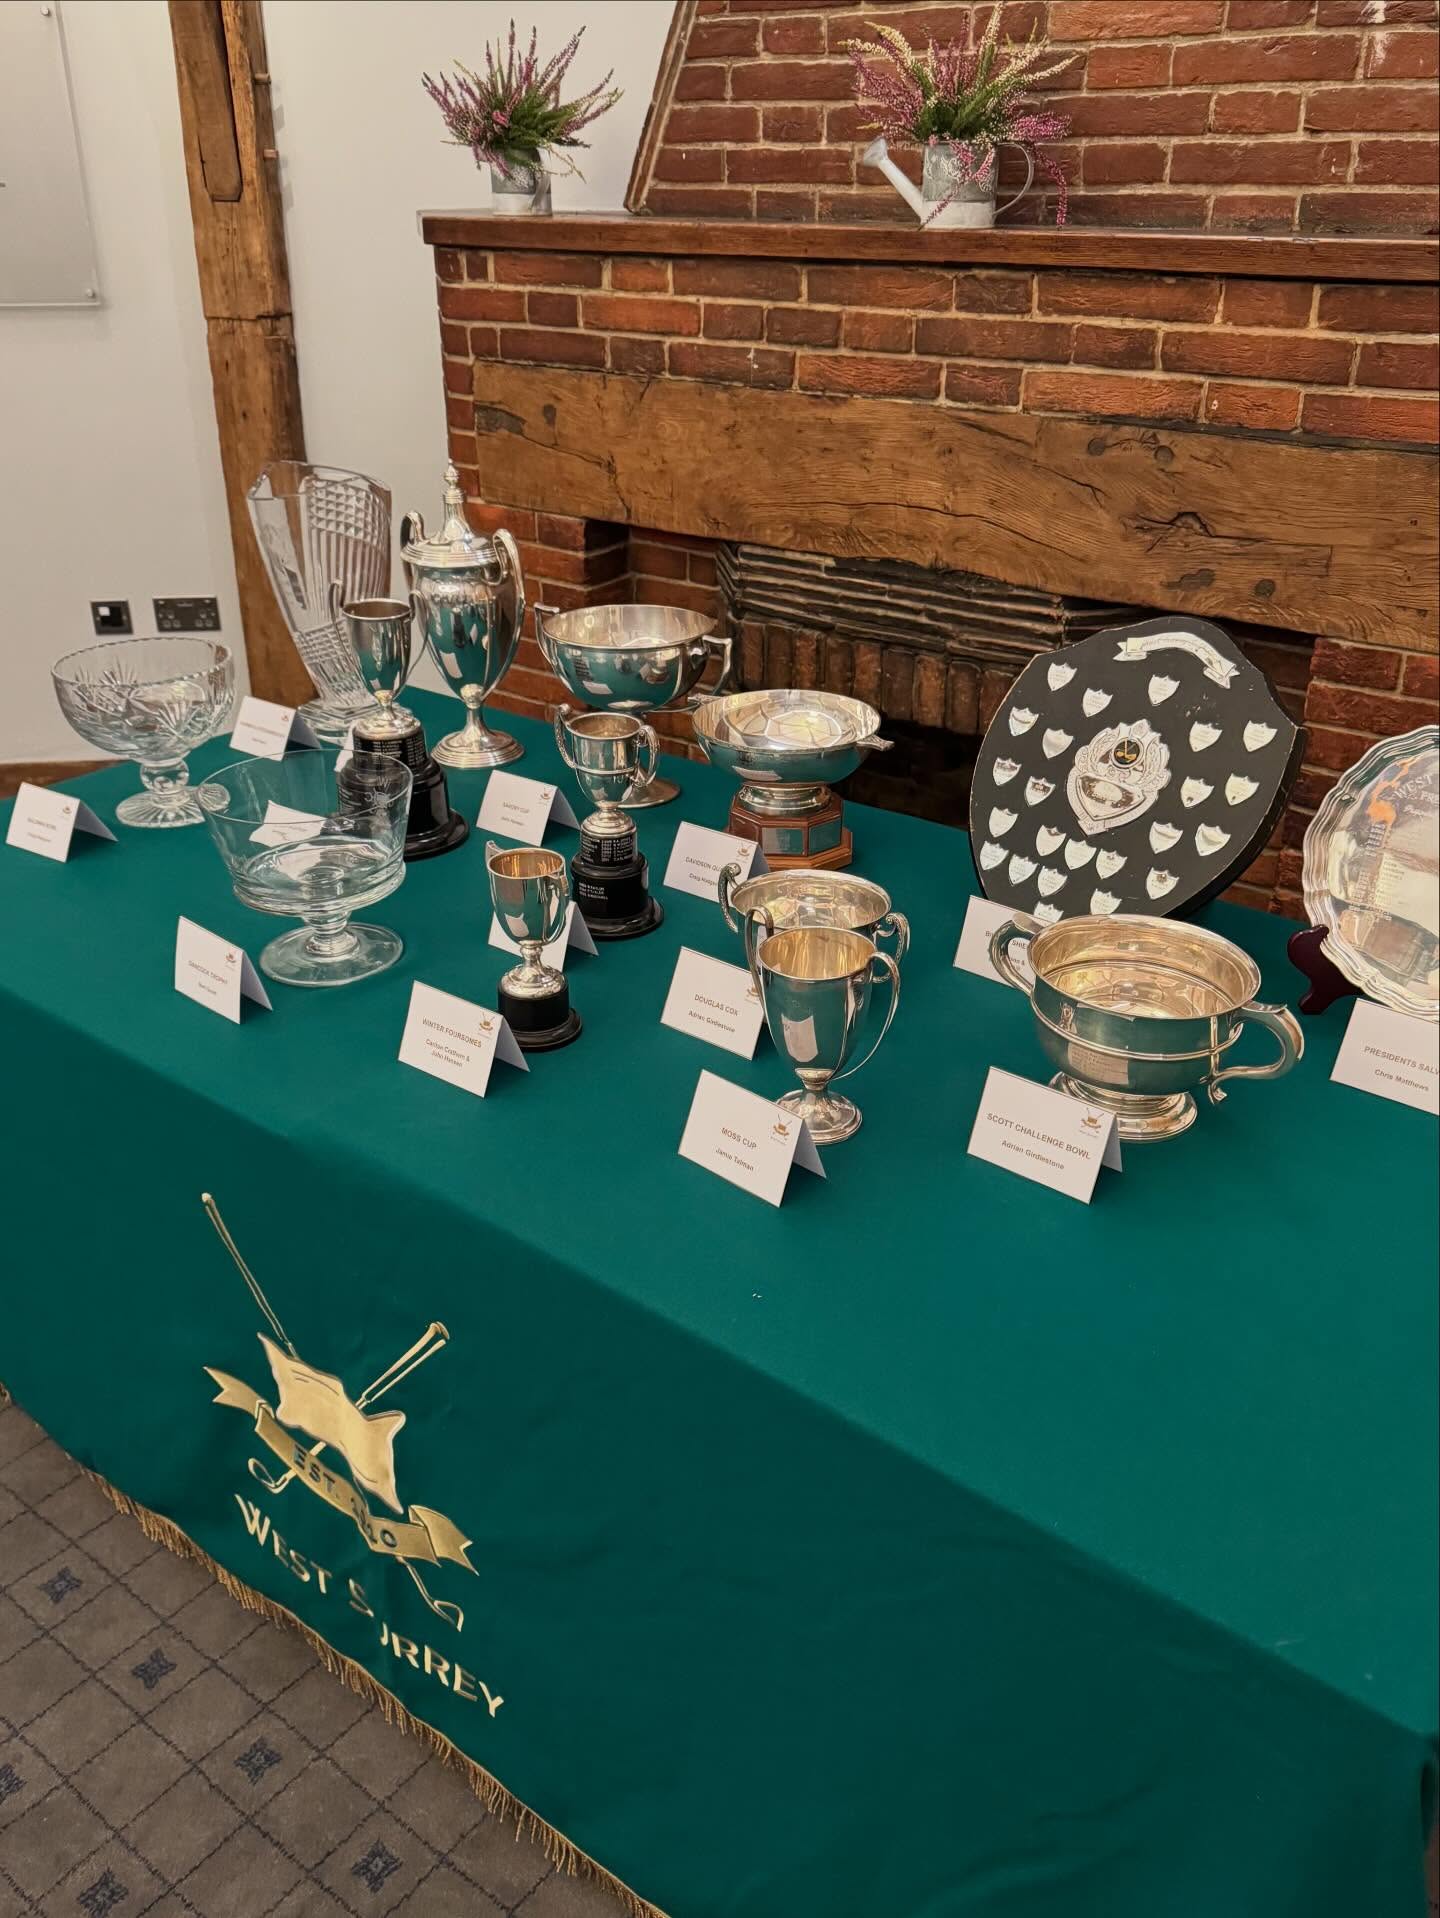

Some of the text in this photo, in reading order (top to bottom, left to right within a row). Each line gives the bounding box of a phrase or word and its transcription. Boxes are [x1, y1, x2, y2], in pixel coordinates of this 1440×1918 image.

[1394, 774, 1432, 799] WEST
[1012, 940, 1026, 950] SHIE
[694, 993, 738, 1017] DOUGLAS COX
[422, 1017, 482, 1048] WINTER FOURSOMES
[1364, 1045, 1417, 1069] PRESIDENTS
[1374, 1069, 1430, 1091] Chris Matthews
[721, 1127, 742, 1143] MOSS
[742, 1137, 757, 1149] CUP
[986, 1112, 1015, 1129] SCOTT
[1015, 1124, 1065, 1149] CHALLENGE
[1065, 1144, 1091, 1160] BOWL
[1001, 1139, 1065, 1170] Adrian Girdlestone
[293, 1443, 340, 1498] EST.
[233, 1492, 333, 1594] WEST
